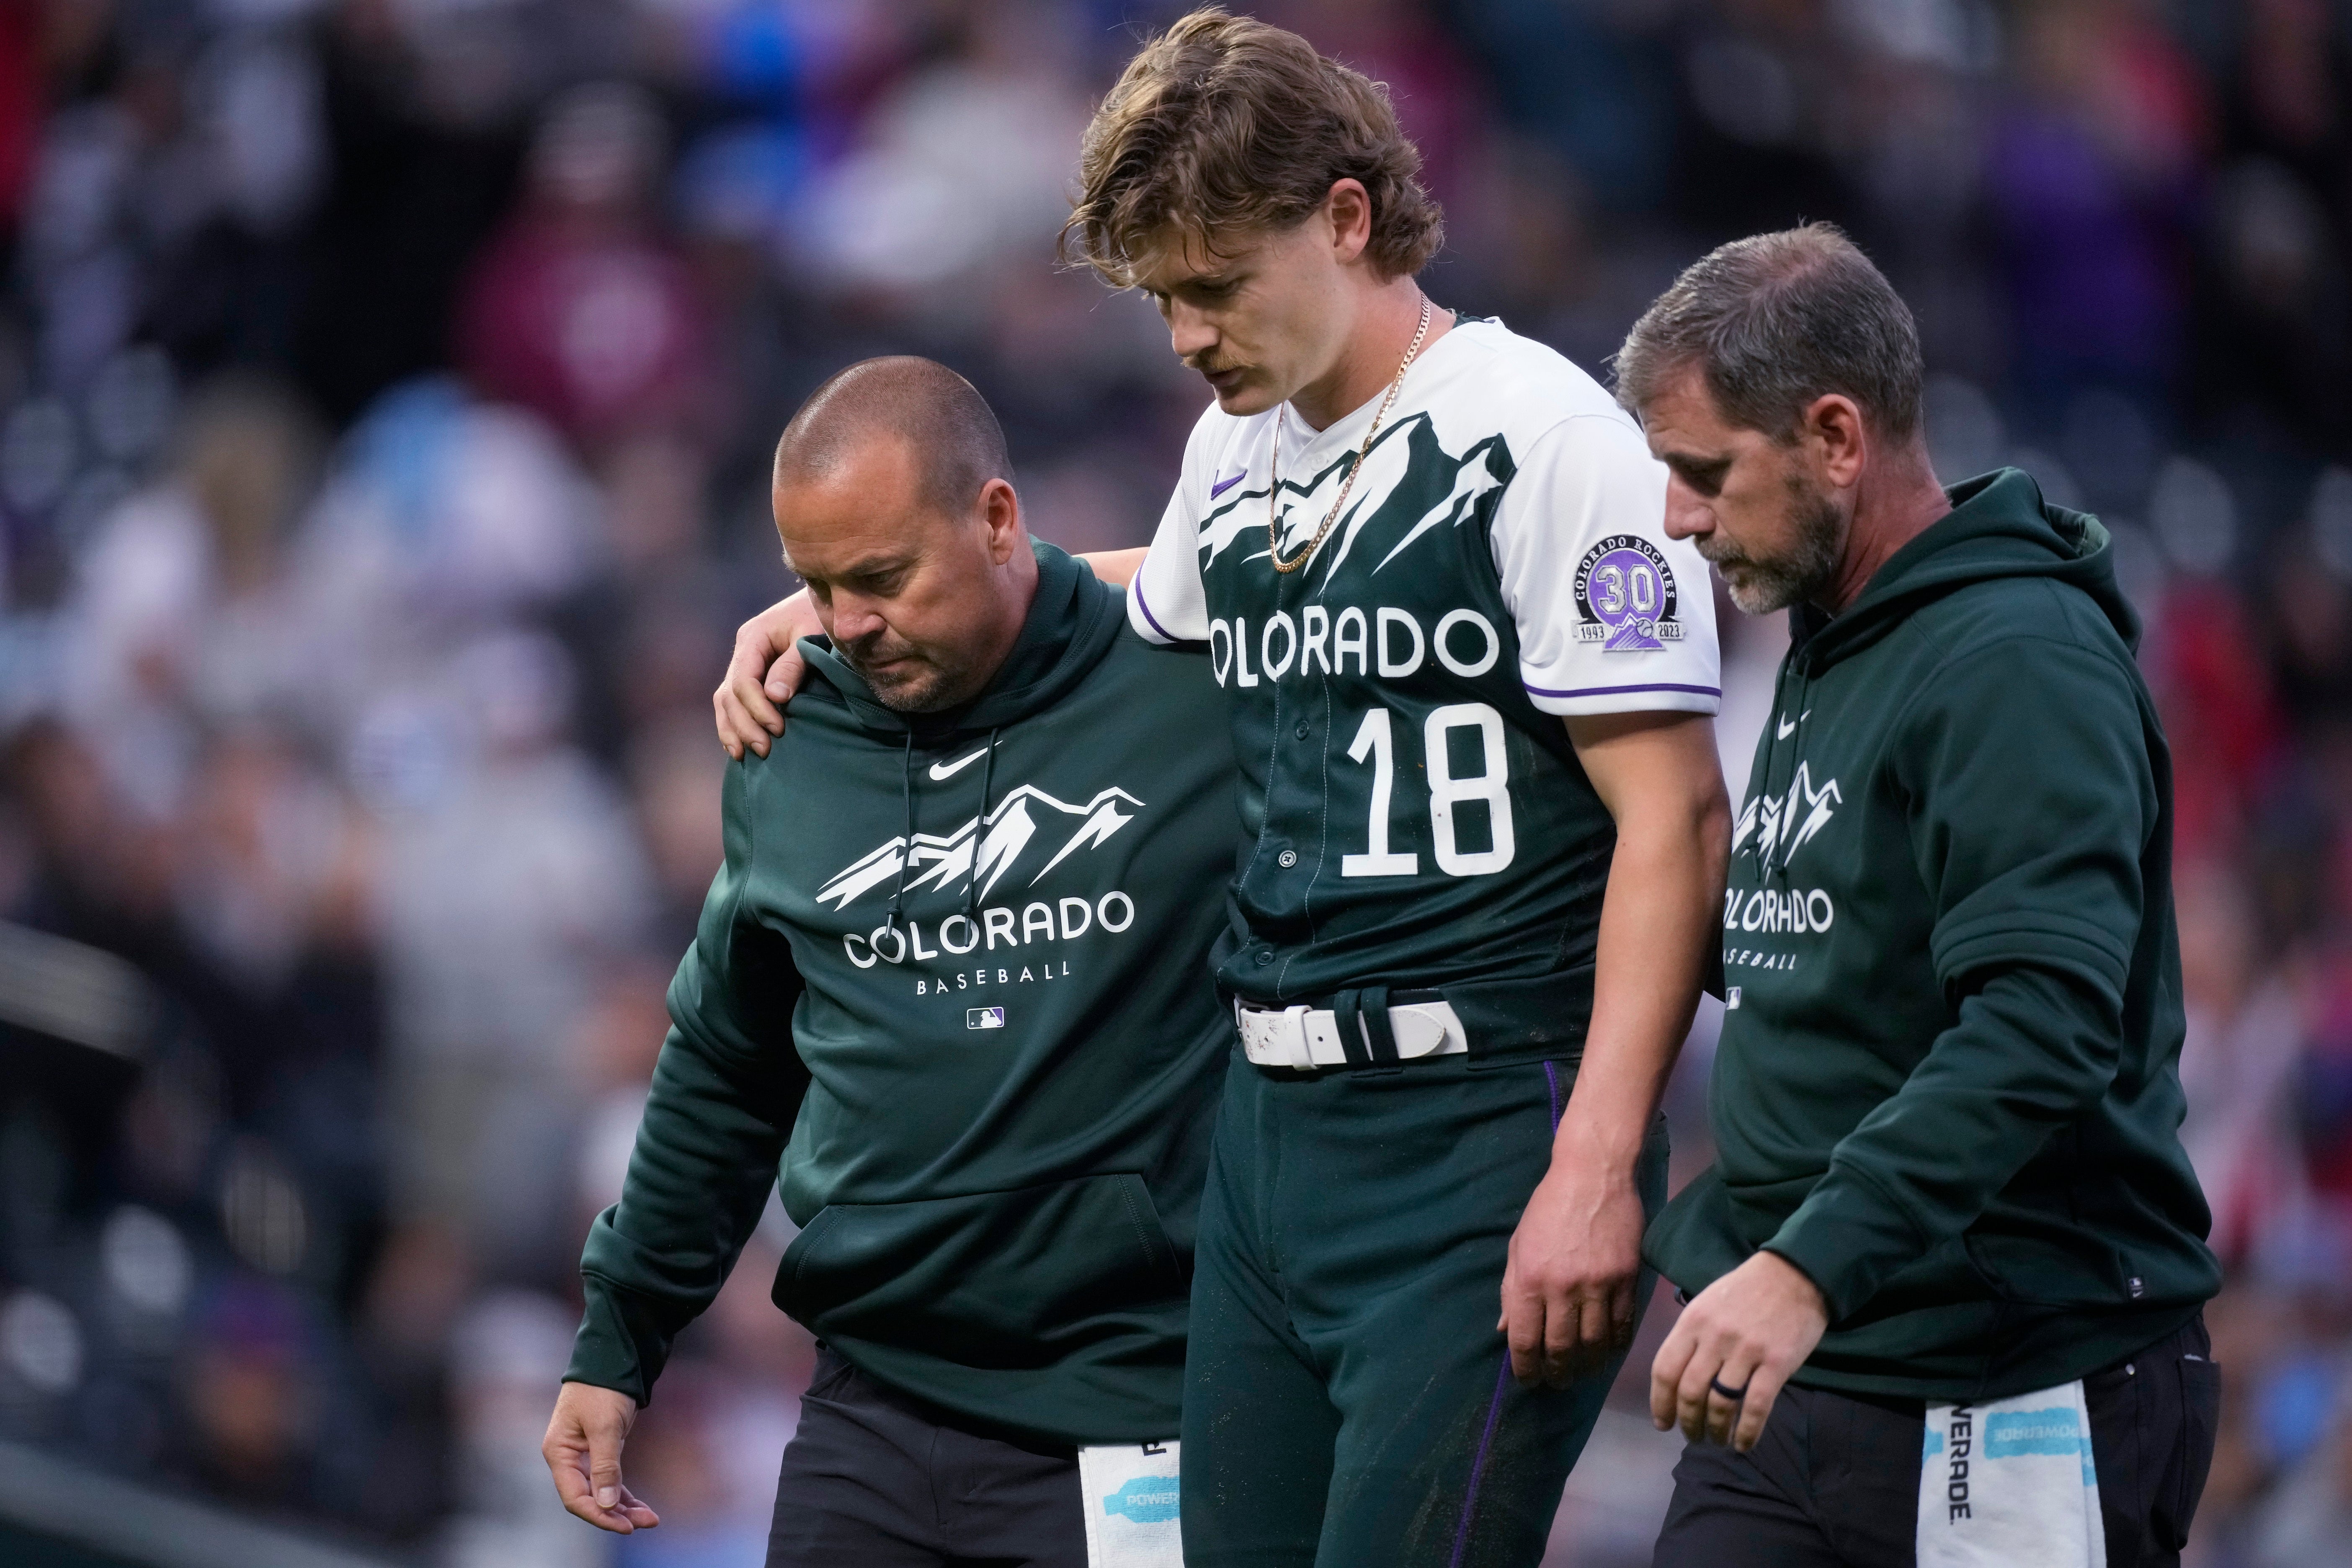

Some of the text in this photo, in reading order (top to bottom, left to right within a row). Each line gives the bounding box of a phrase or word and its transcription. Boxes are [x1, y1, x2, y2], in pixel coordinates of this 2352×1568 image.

[1575, 536, 1675, 600] COLORADO ROCKIES
[1595, 564, 1656, 614] 30
[1581, 626, 1604, 640] 1993
[1658, 624, 1680, 637] 2023
[1341, 702, 1515, 877] 18
[843, 890, 1135, 968] COLORADO
[917, 961, 1069, 995] BASEBALL
